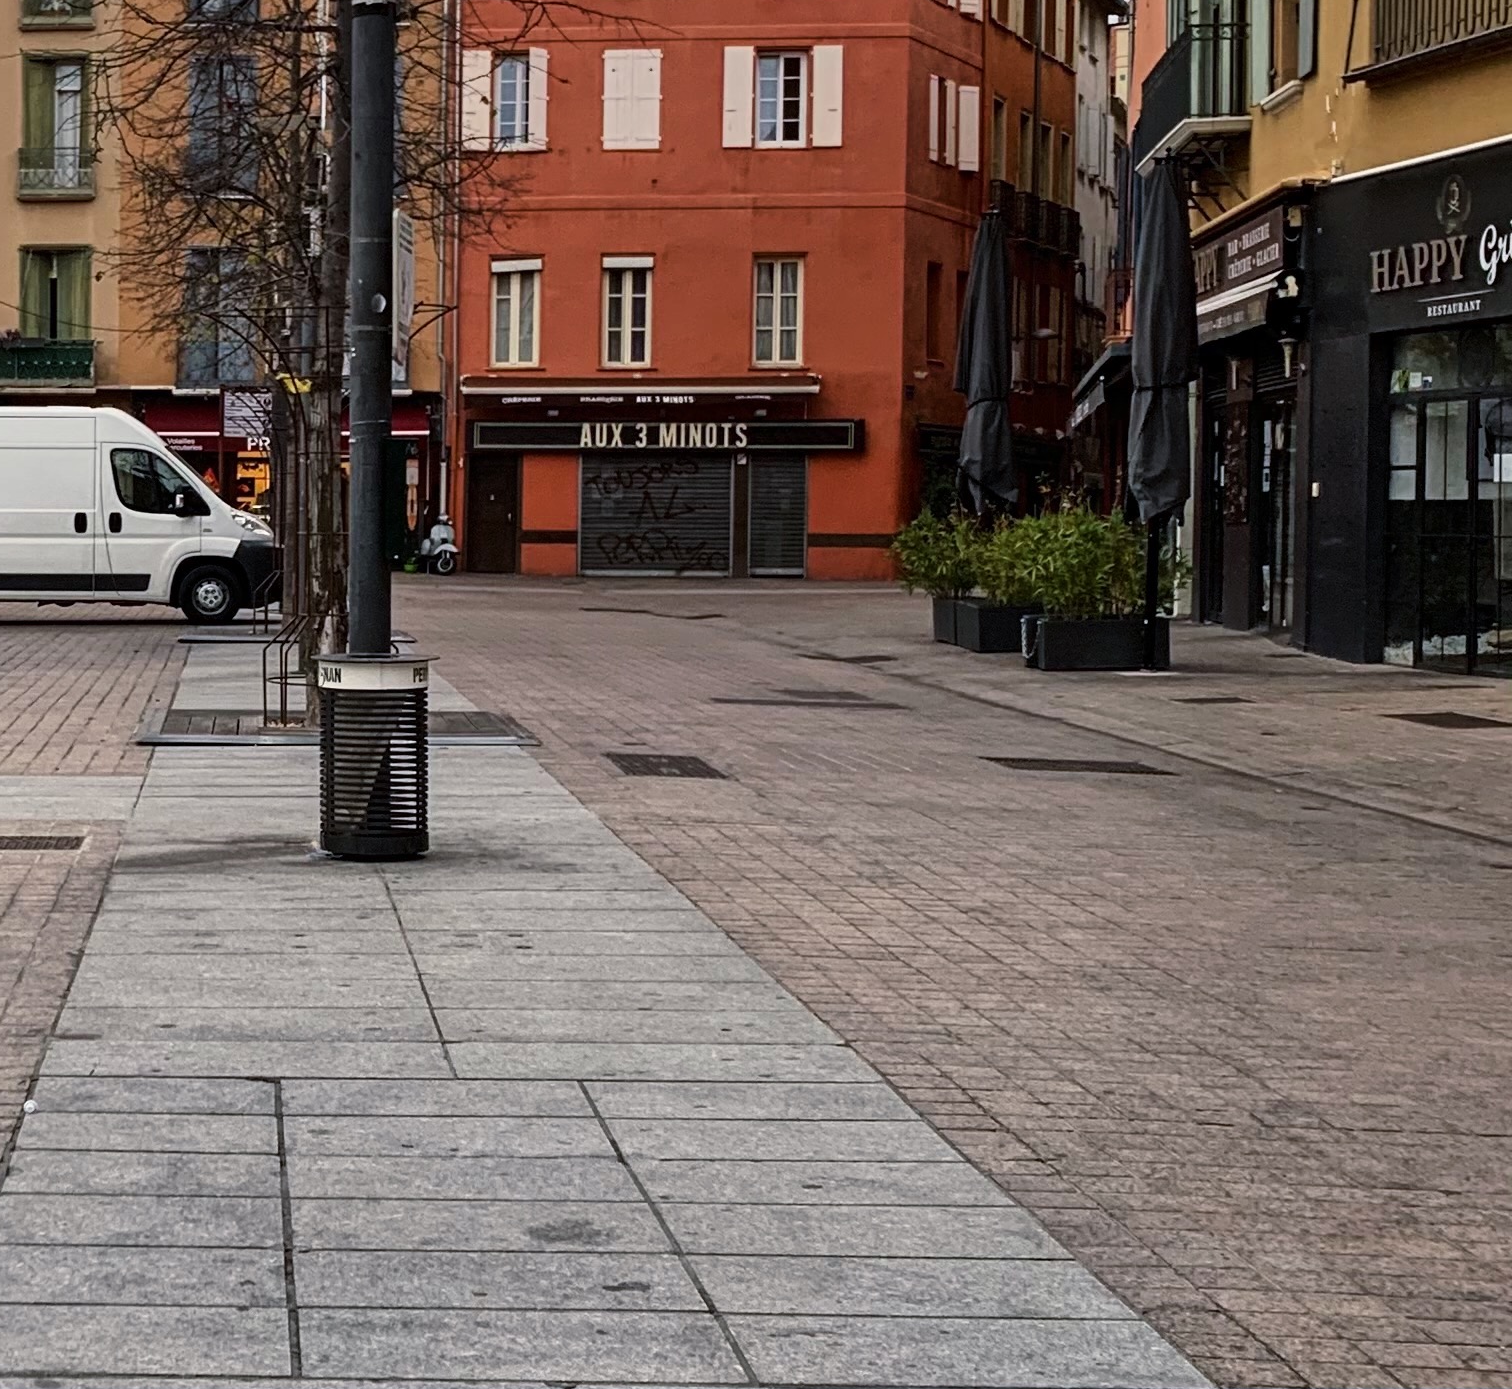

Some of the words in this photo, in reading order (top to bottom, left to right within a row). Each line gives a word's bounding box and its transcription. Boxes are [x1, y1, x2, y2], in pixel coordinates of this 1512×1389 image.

[1192, 244, 1219, 294] APPY
[1370, 235, 1467, 293] HAPPY
[1427, 300, 1481, 317] RESTAURANT
[662, 396, 694, 404] MINOTS
[580, 423, 623, 448] AUX
[635, 423, 647, 448] 3
[659, 423, 748, 448] MINOTS
